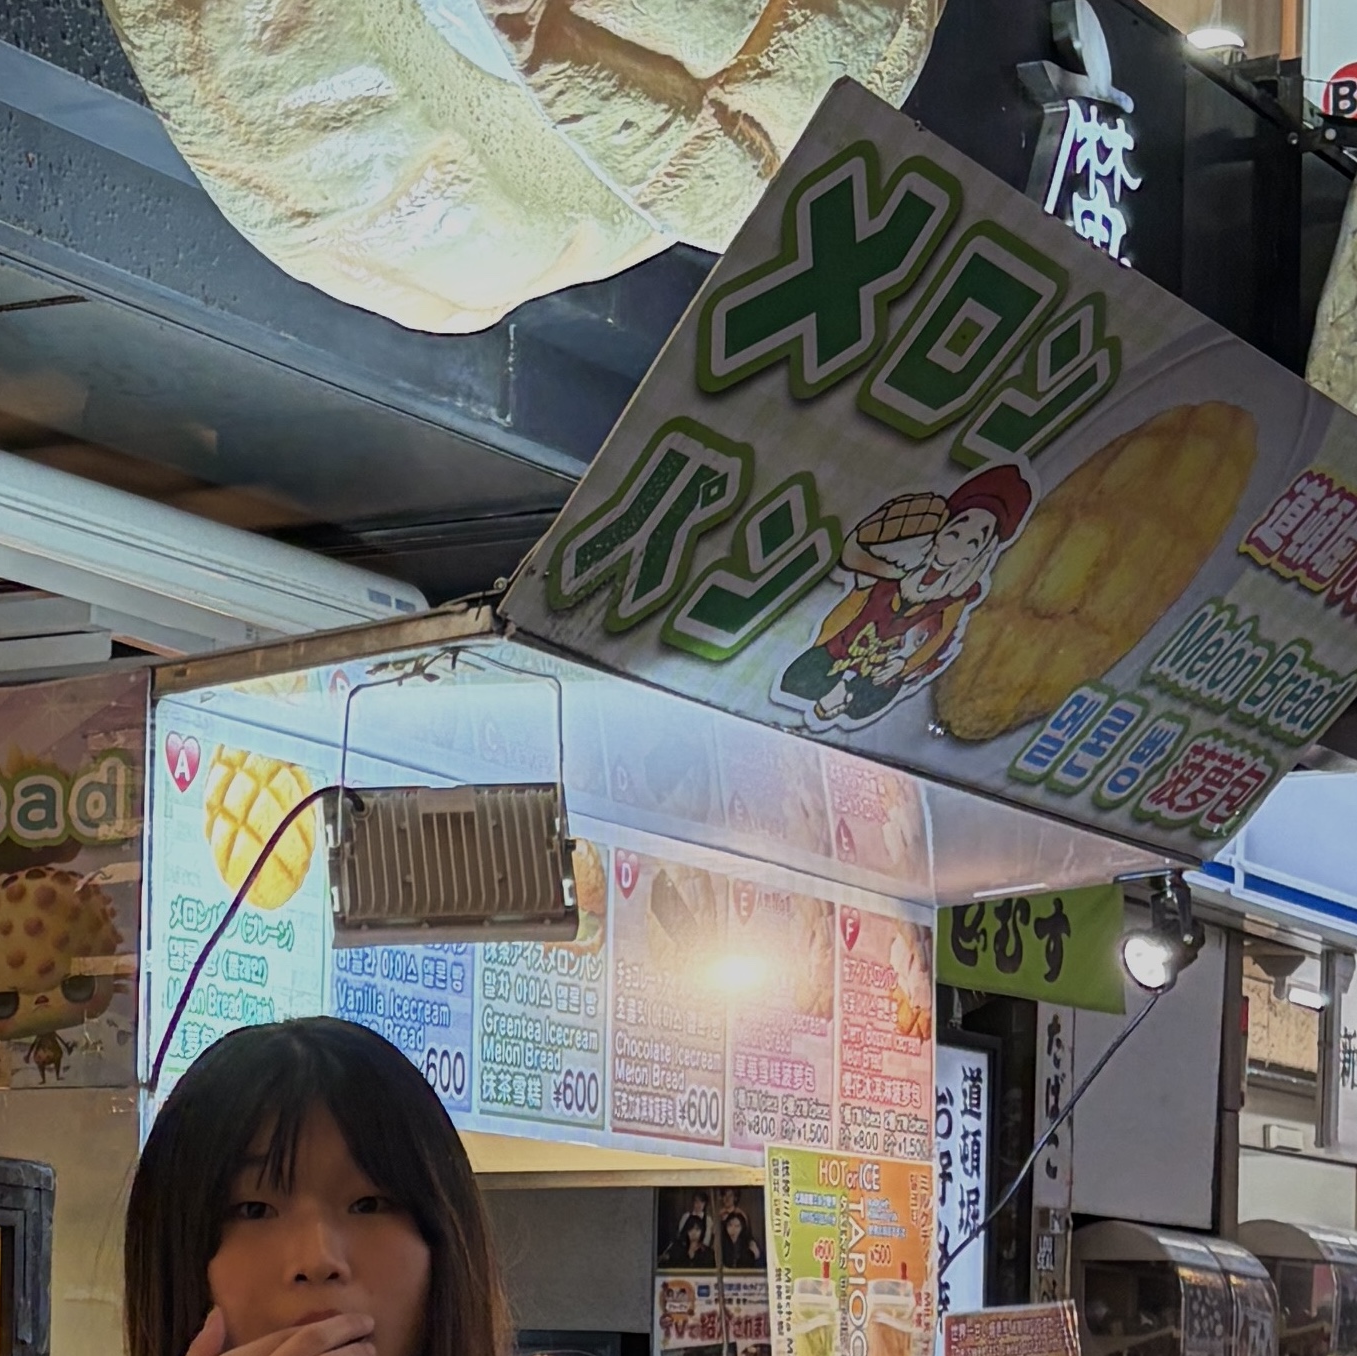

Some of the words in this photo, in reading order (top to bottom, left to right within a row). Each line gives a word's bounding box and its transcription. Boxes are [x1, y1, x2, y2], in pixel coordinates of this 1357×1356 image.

[704, 148, 1121, 458] メロン
[552, 420, 839, 658] パン
[1148, 601, 1274, 706] Melon
[1236, 642, 1357, 738] Bread
[336, 980, 385, 1017] Vanilla
[390, 988, 450, 1027] Icecream
[384, 1017, 425, 1051] Bread
[483, 1004, 542, 1043] Greentea
[545, 1015, 599, 1053] Icecream
[615, 1030, 672, 1064] Chocolate
[482, 1036, 521, 1067] Melon
[524, 1043, 562, 1073] Bread
[614, 1058, 649, 1086] Melon
[652, 1064, 685, 1091] Bread
[481, 1069, 542, 1108] 抹茶雪糕
[552, 1067, 600, 1115] ¥600
[677, 1086, 721, 1132] ¥600
[817, 1158, 848, 1188] HOT
[859, 1162, 881, 1192] ICE
[958, 1065, 984, 1240] 道頓堀
